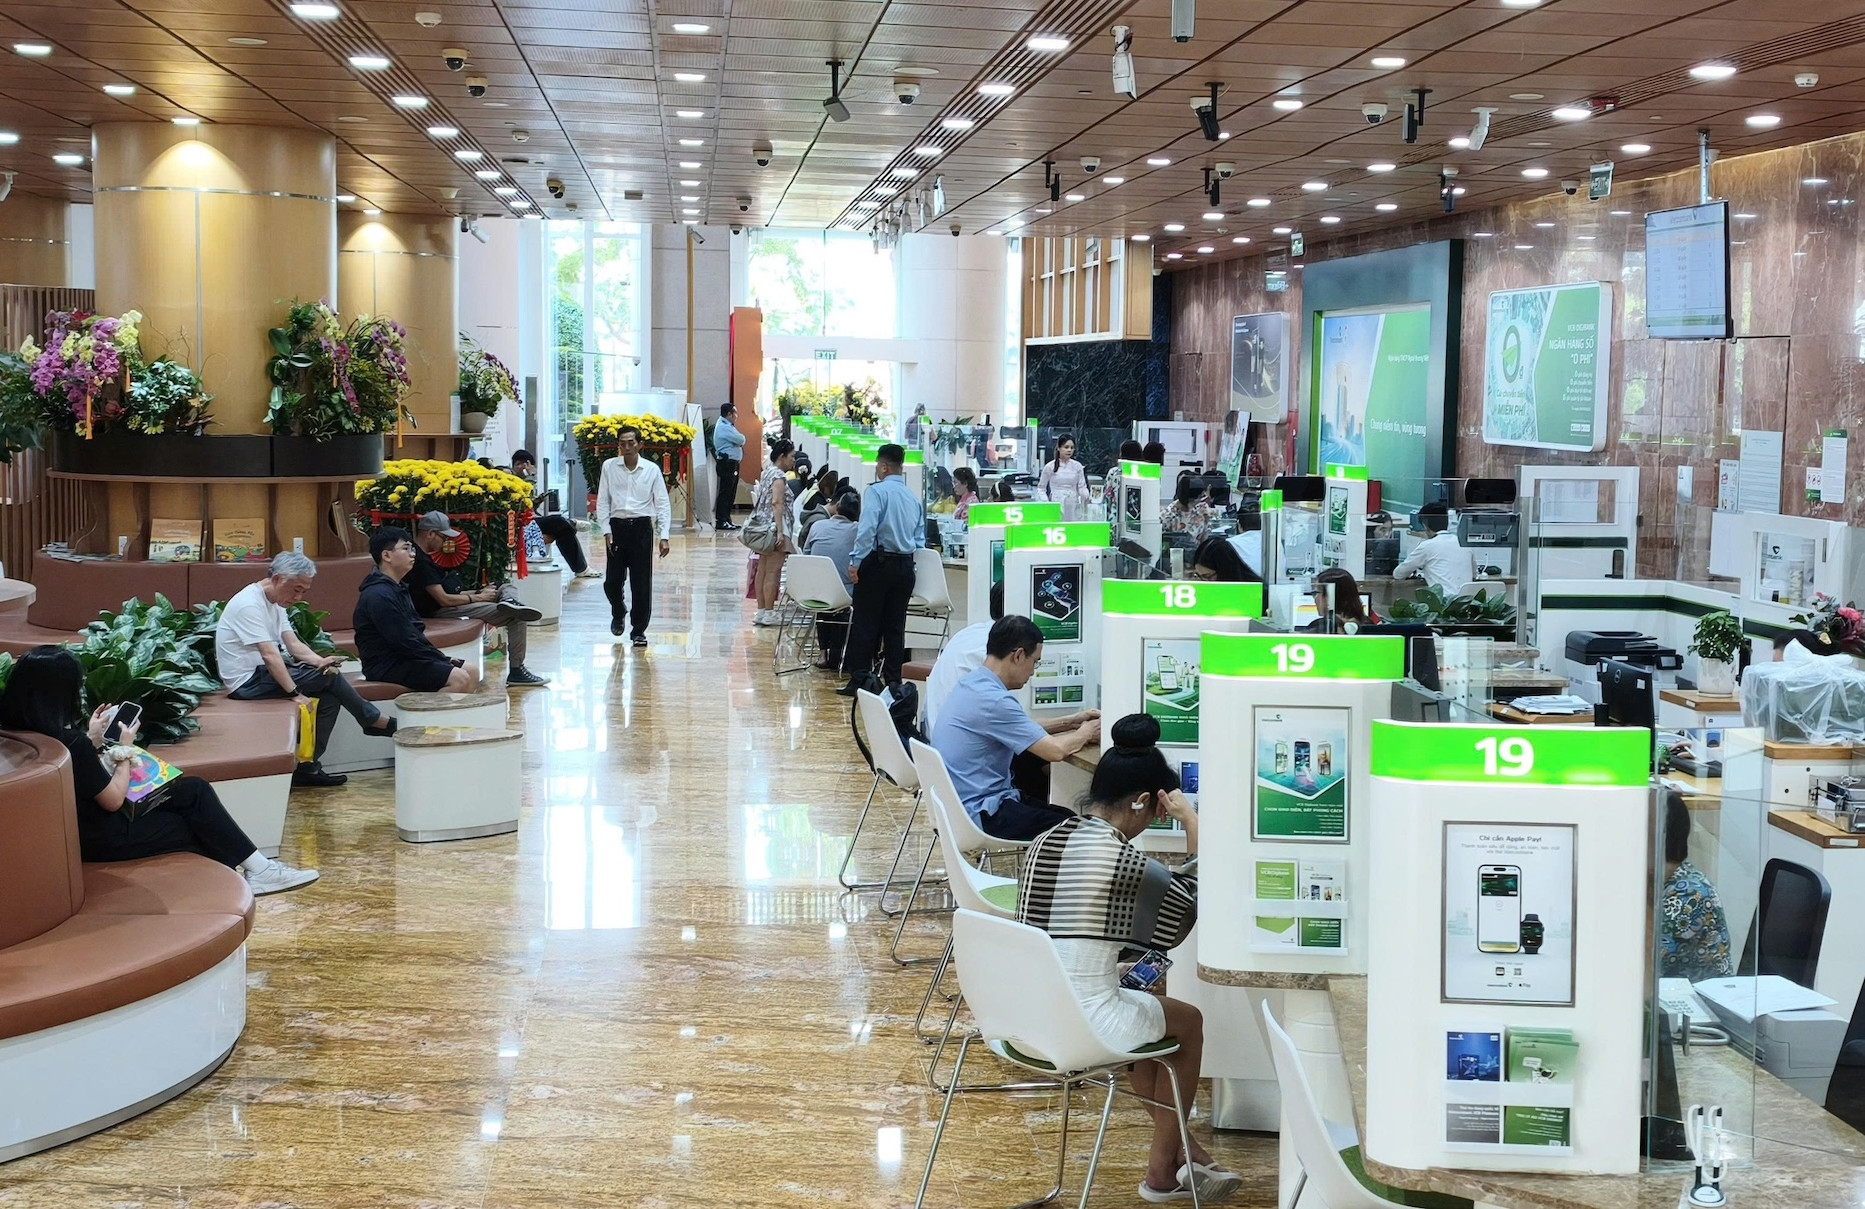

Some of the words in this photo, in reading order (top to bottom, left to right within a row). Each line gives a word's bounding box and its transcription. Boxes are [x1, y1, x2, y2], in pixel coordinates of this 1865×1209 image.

[815, 351, 836, 359] EXIT
[1002, 507, 1023, 522] 15
[1042, 527, 1066, 545] 16
[1159, 584, 1196, 608] 18
[1270, 643, 1315, 673] 19
[1474, 736, 1535, 777] 19
